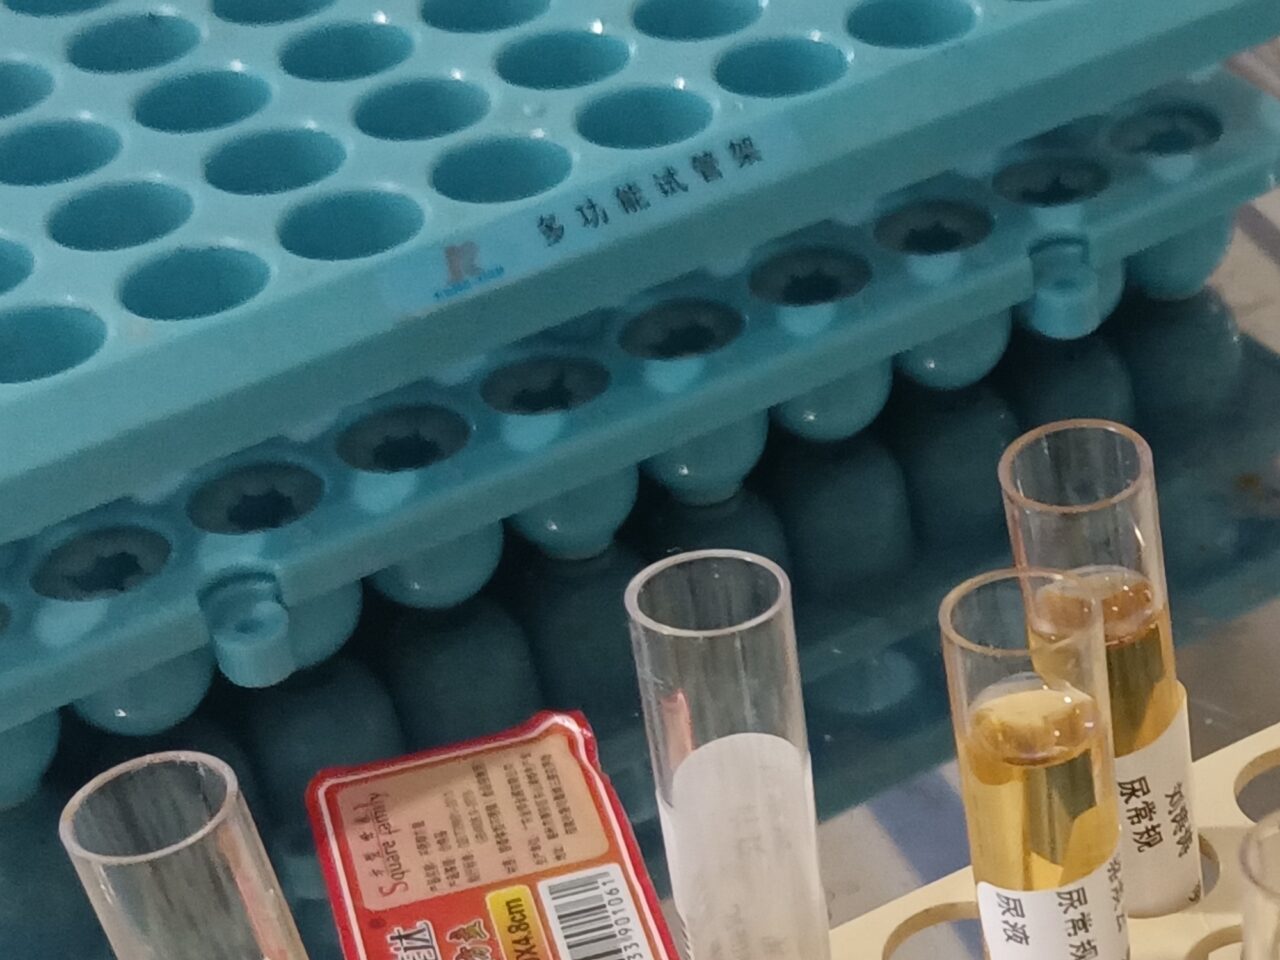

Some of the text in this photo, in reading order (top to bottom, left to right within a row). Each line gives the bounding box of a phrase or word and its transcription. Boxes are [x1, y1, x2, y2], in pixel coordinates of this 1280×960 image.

[536, 135, 764, 248] 多功能试管架
[1117, 775, 1164, 854] 尿常规
[377, 837, 413, 898] Square
[996, 891, 1031, 947] 尿液
